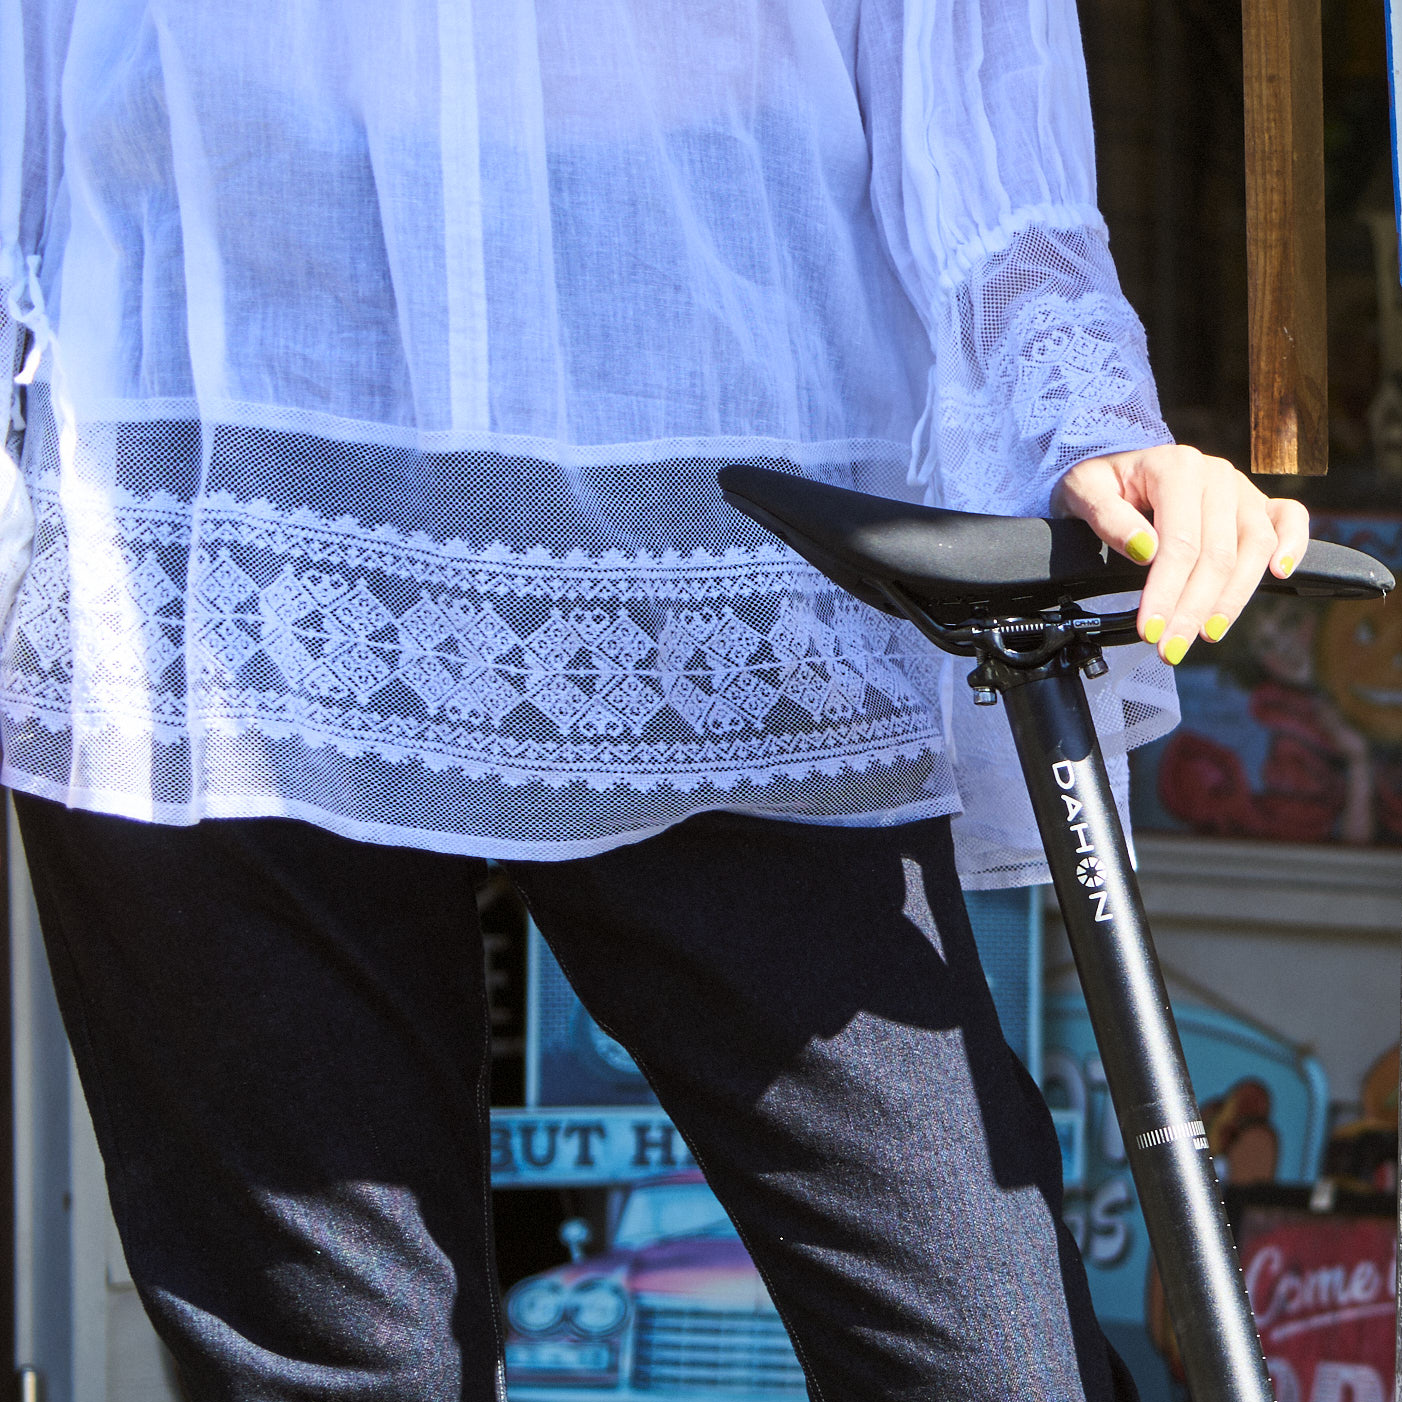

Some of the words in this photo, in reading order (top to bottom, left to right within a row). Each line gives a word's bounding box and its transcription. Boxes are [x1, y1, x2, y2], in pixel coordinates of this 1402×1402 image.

[1052, 760, 1113, 923] DAHON
[490, 1120, 607, 1172] BUT
[632, 1120, 698, 1167] H
[1243, 1244, 1376, 1329] Come
